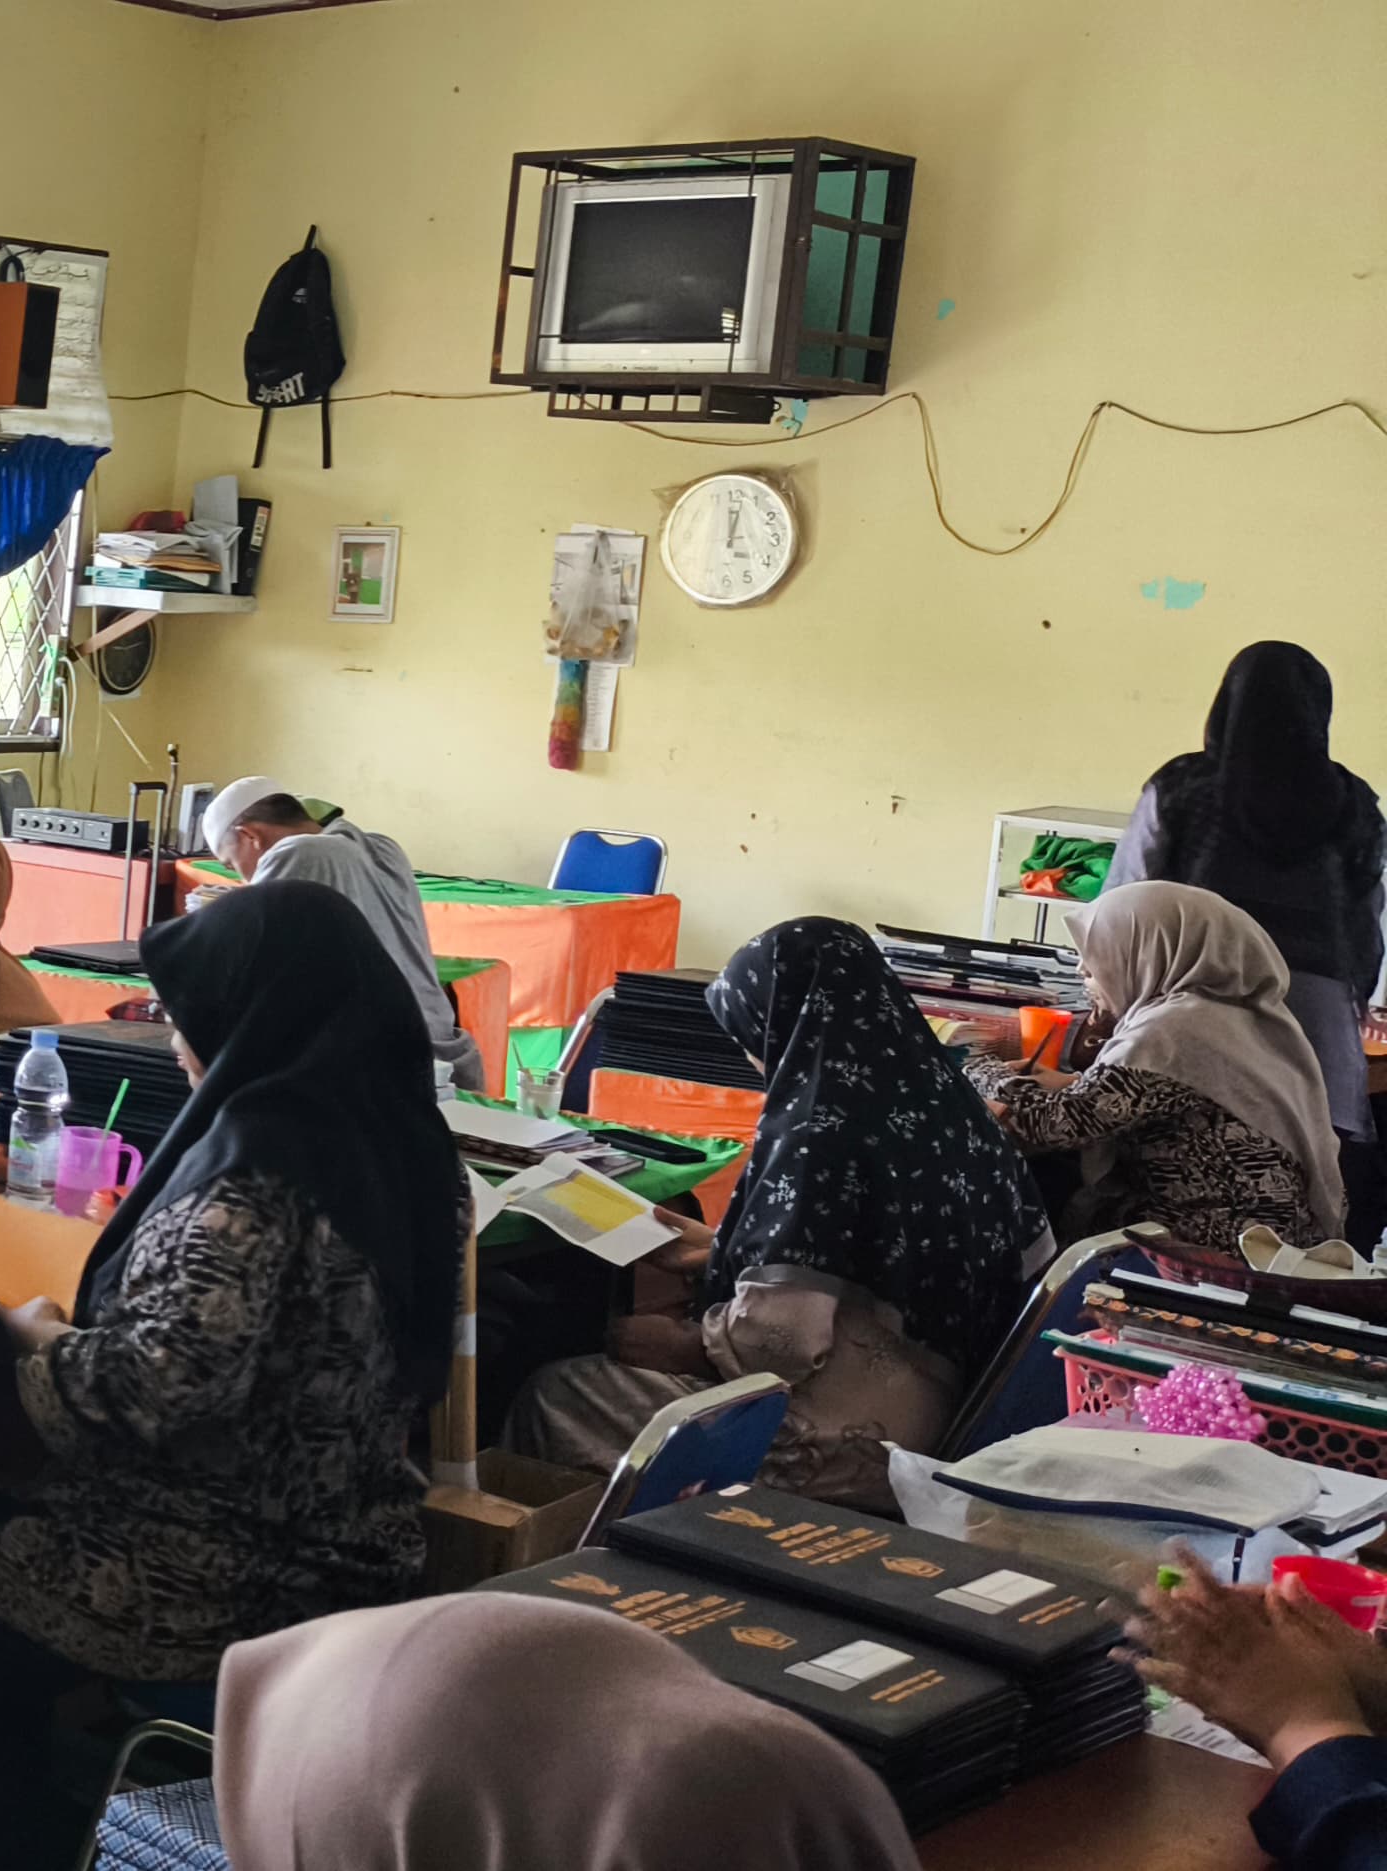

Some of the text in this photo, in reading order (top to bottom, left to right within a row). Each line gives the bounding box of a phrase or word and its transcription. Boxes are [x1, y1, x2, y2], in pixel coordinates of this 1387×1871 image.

[765, 511, 777, 526] 2
[769, 532, 781, 548] 3
[742, 570, 753, 584] 5
